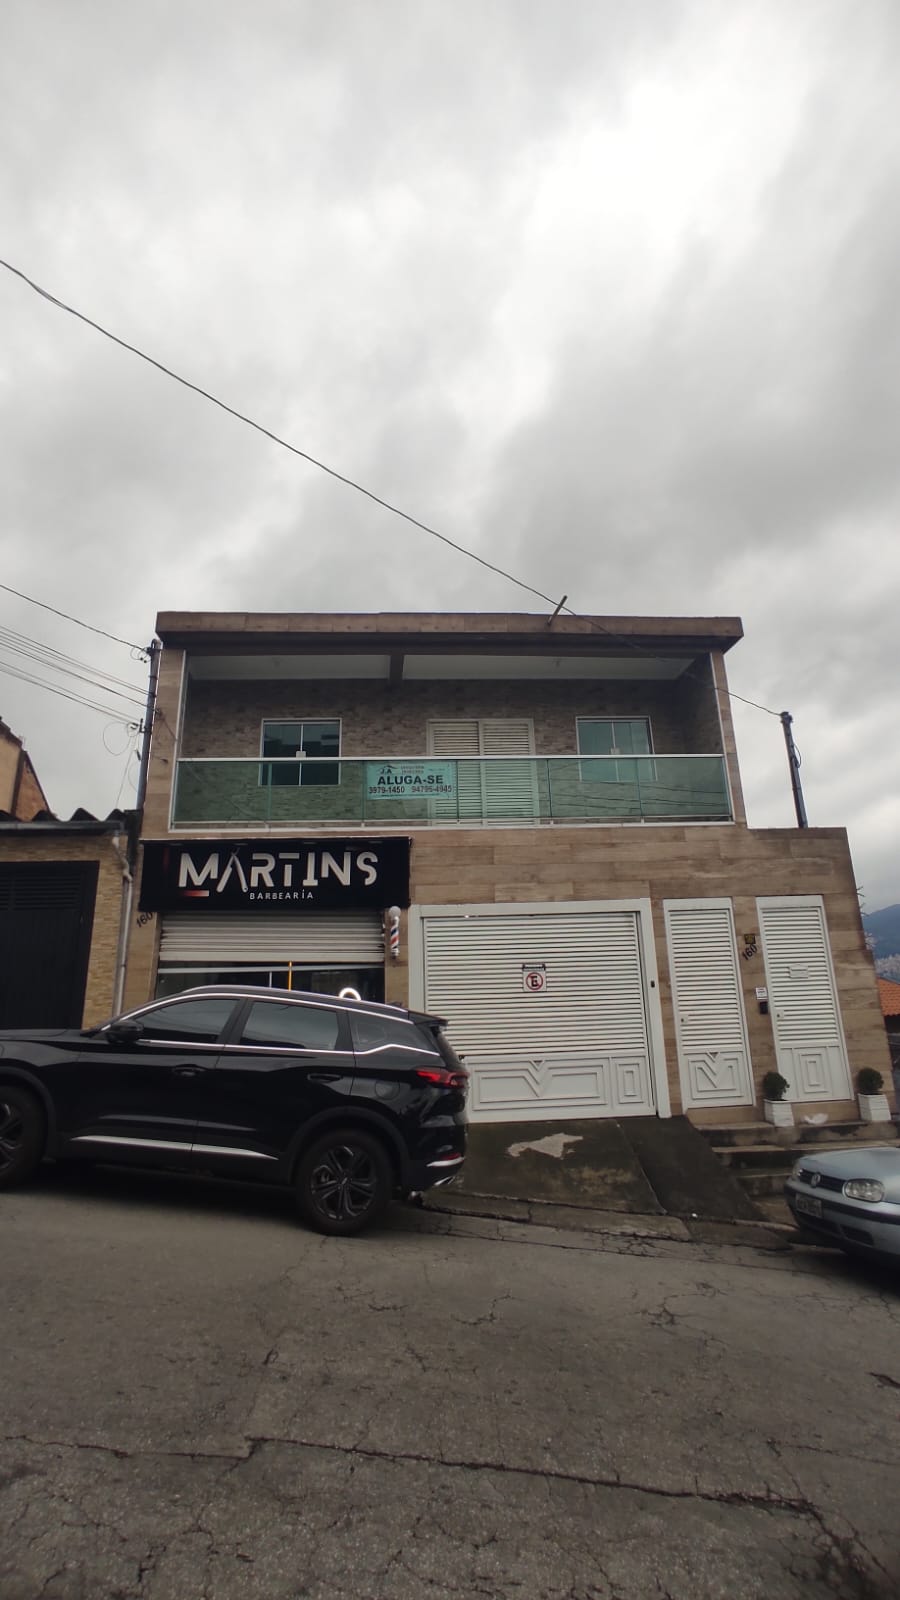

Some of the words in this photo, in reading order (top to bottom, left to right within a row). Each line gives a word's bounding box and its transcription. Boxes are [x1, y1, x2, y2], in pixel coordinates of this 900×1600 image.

[377, 775, 443, 785] ALUGA-SE
[179, 849, 378, 892] MARTINS
[742, 944, 757, 960] 160
